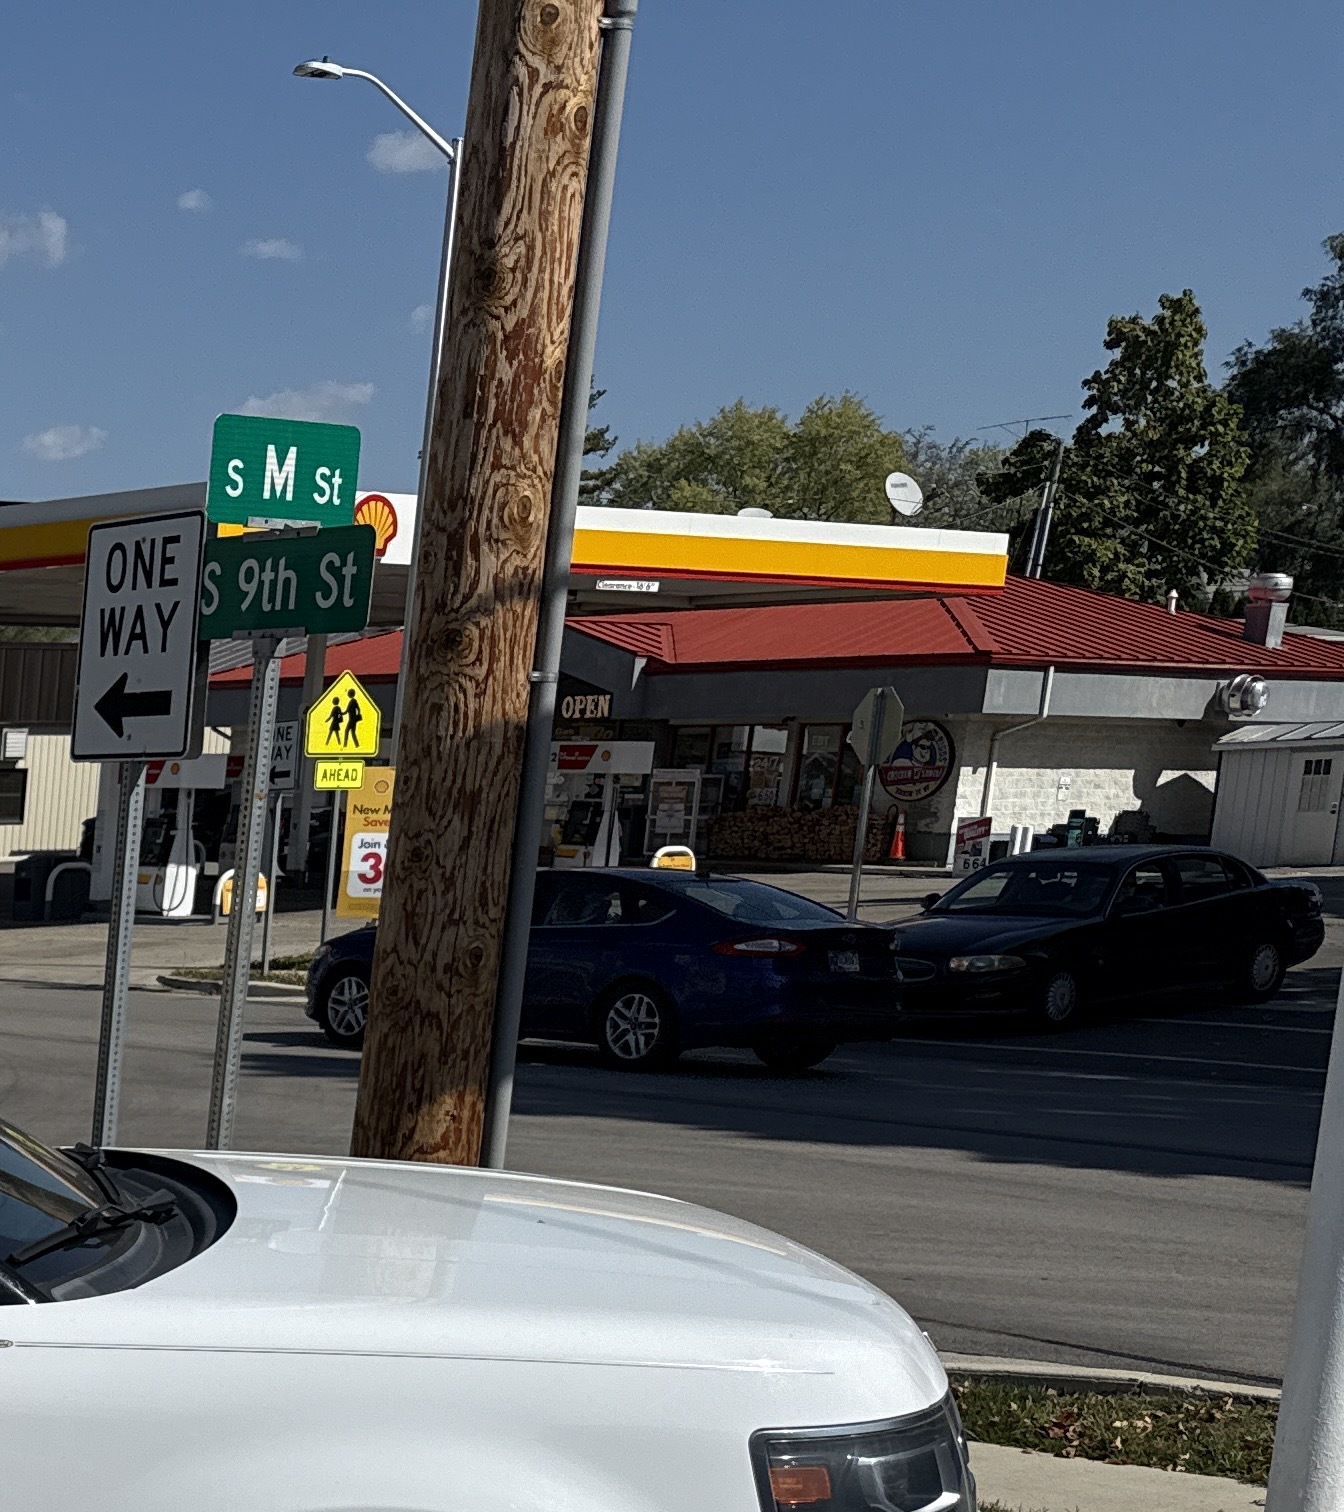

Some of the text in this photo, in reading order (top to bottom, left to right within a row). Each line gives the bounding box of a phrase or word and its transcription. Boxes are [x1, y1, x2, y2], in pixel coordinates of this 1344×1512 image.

[225, 444, 343, 506] S M St
[105, 534, 181, 594] ONE
[200, 551, 358, 616] S 9th St
[99, 600, 181, 658] WAY
[561, 694, 611, 719] OPEN
[272, 725, 293, 742] NE
[271, 744, 292, 761] AY
[321, 768, 358, 782] AHEAD
[352, 804, 380, 815] New
[358, 838, 381, 849] Join
[357, 852, 383, 885] 3
